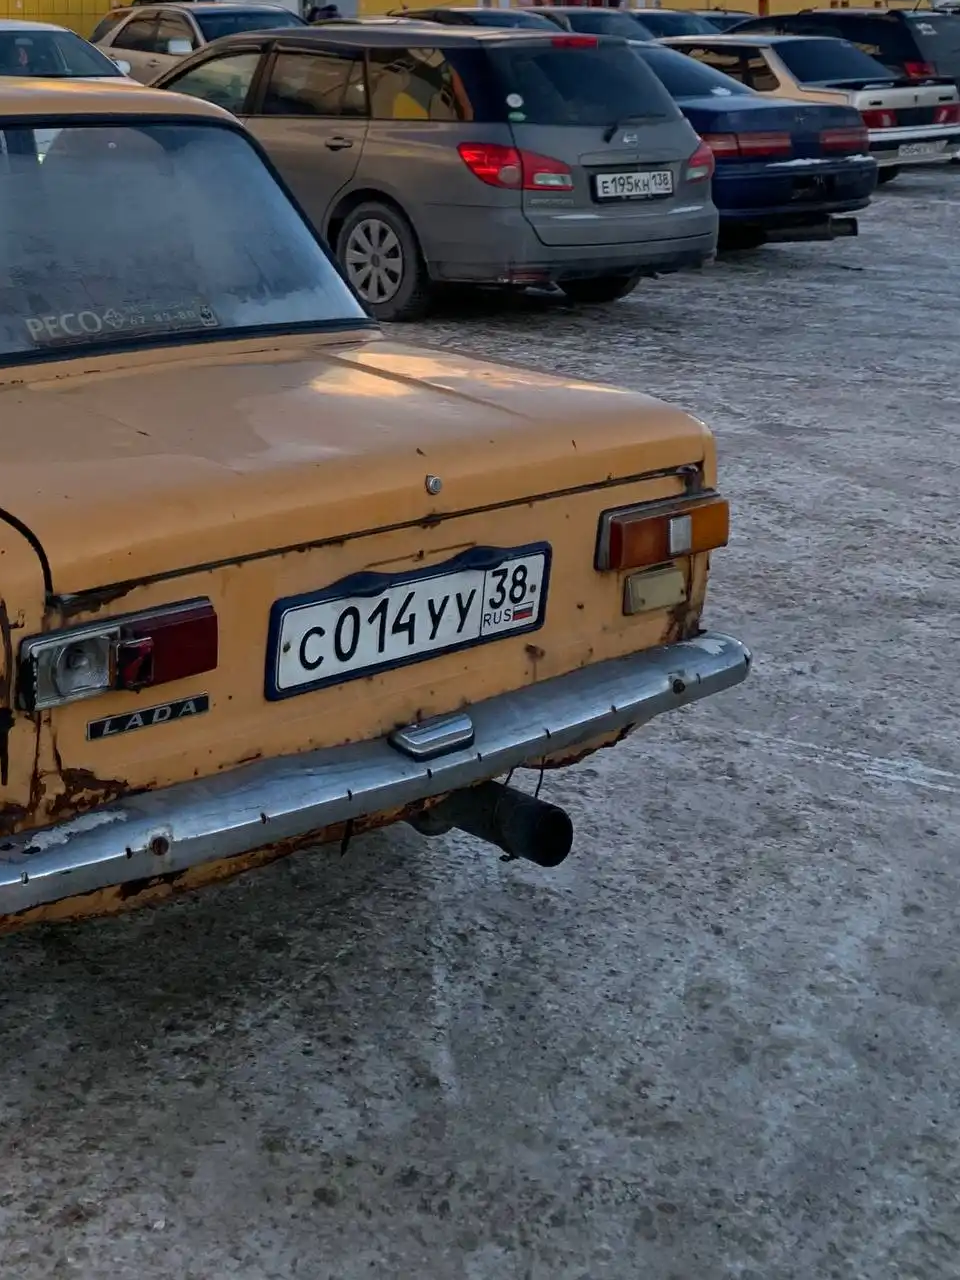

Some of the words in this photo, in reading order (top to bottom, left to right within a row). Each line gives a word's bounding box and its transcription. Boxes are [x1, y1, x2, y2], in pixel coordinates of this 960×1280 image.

[651, 173, 669, 187] 138
[298, 589, 477, 670] С014УУ
[489, 564, 529, 609] 38
[483, 609, 512, 629] RUS
[102, 700, 197, 737] LADA
